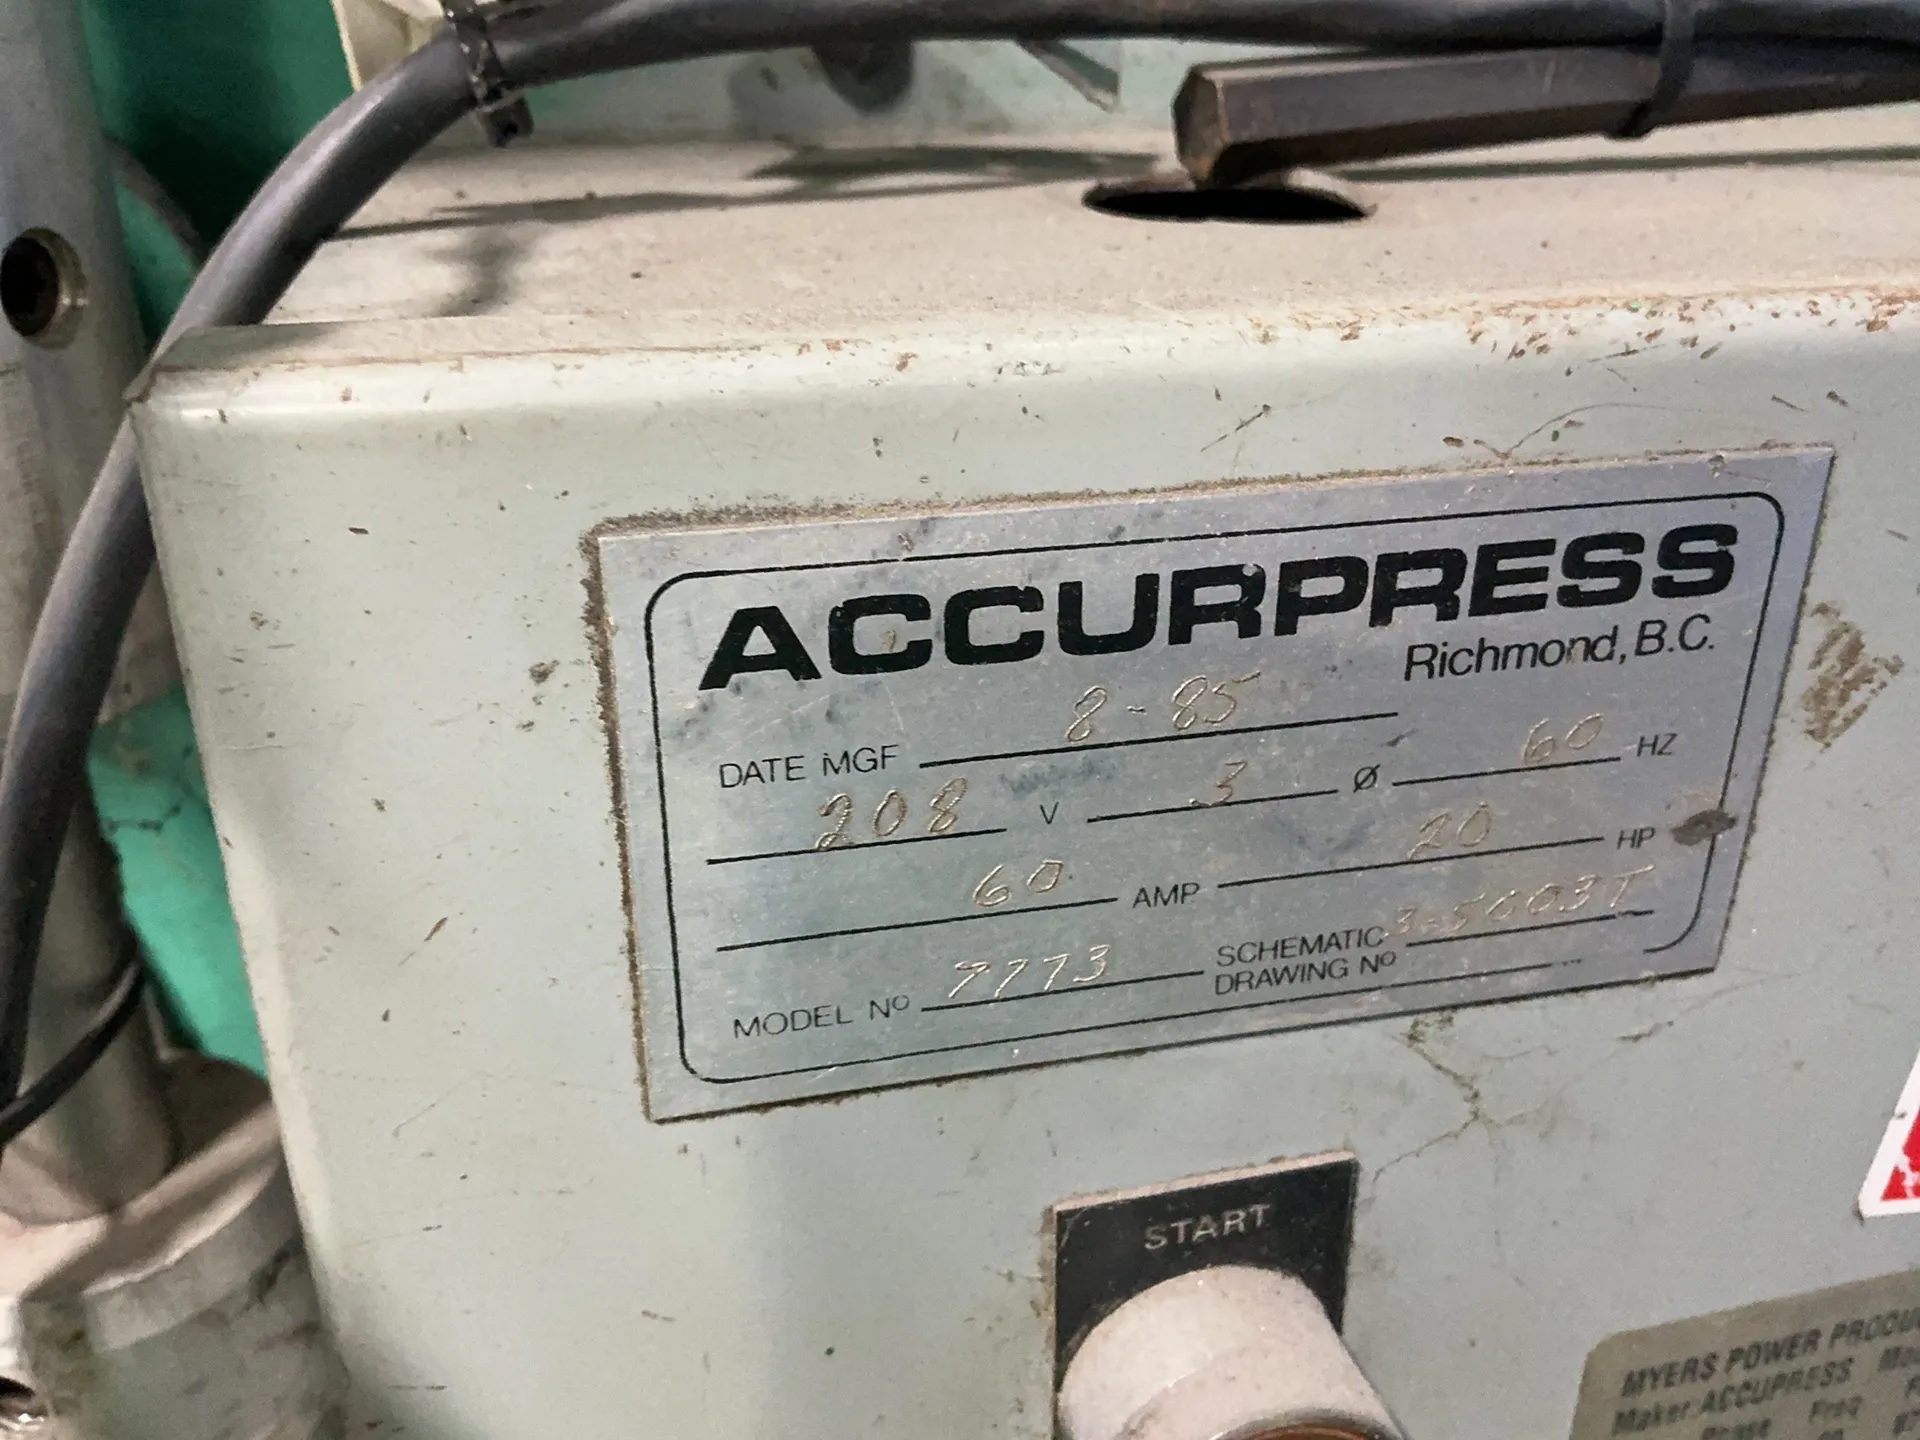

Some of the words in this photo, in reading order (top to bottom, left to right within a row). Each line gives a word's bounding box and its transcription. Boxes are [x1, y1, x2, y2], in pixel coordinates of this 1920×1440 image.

[699, 522, 1739, 690] ACCURPRESS
[1404, 624, 1627, 682] Richmond,
[1634, 613, 1714, 656] B.C.
[1522, 712, 1605, 765] 60
[1636, 732, 1678, 757] HZ
[719, 756, 806, 789] DATE
[822, 745, 899, 776] MGF
[1188, 759, 1249, 808] 3
[814, 777, 968, 852] 208
[1039, 802, 1060, 826] V
[1406, 800, 1493, 861] 20
[1616, 827, 1656, 850] HP
[971, 858, 1065, 907] 60
[1132, 880, 1200, 909] AMP
[1216, 925, 1385, 968] SCHEMATIC
[1214, 957, 1350, 996] DRAWING
[733, 1003, 854, 1038] MODEL
[1143, 1203, 1271, 1251] START
[1621, 1350, 1721, 1398] MYERS
[1725, 1327, 1823, 1374] POWER
